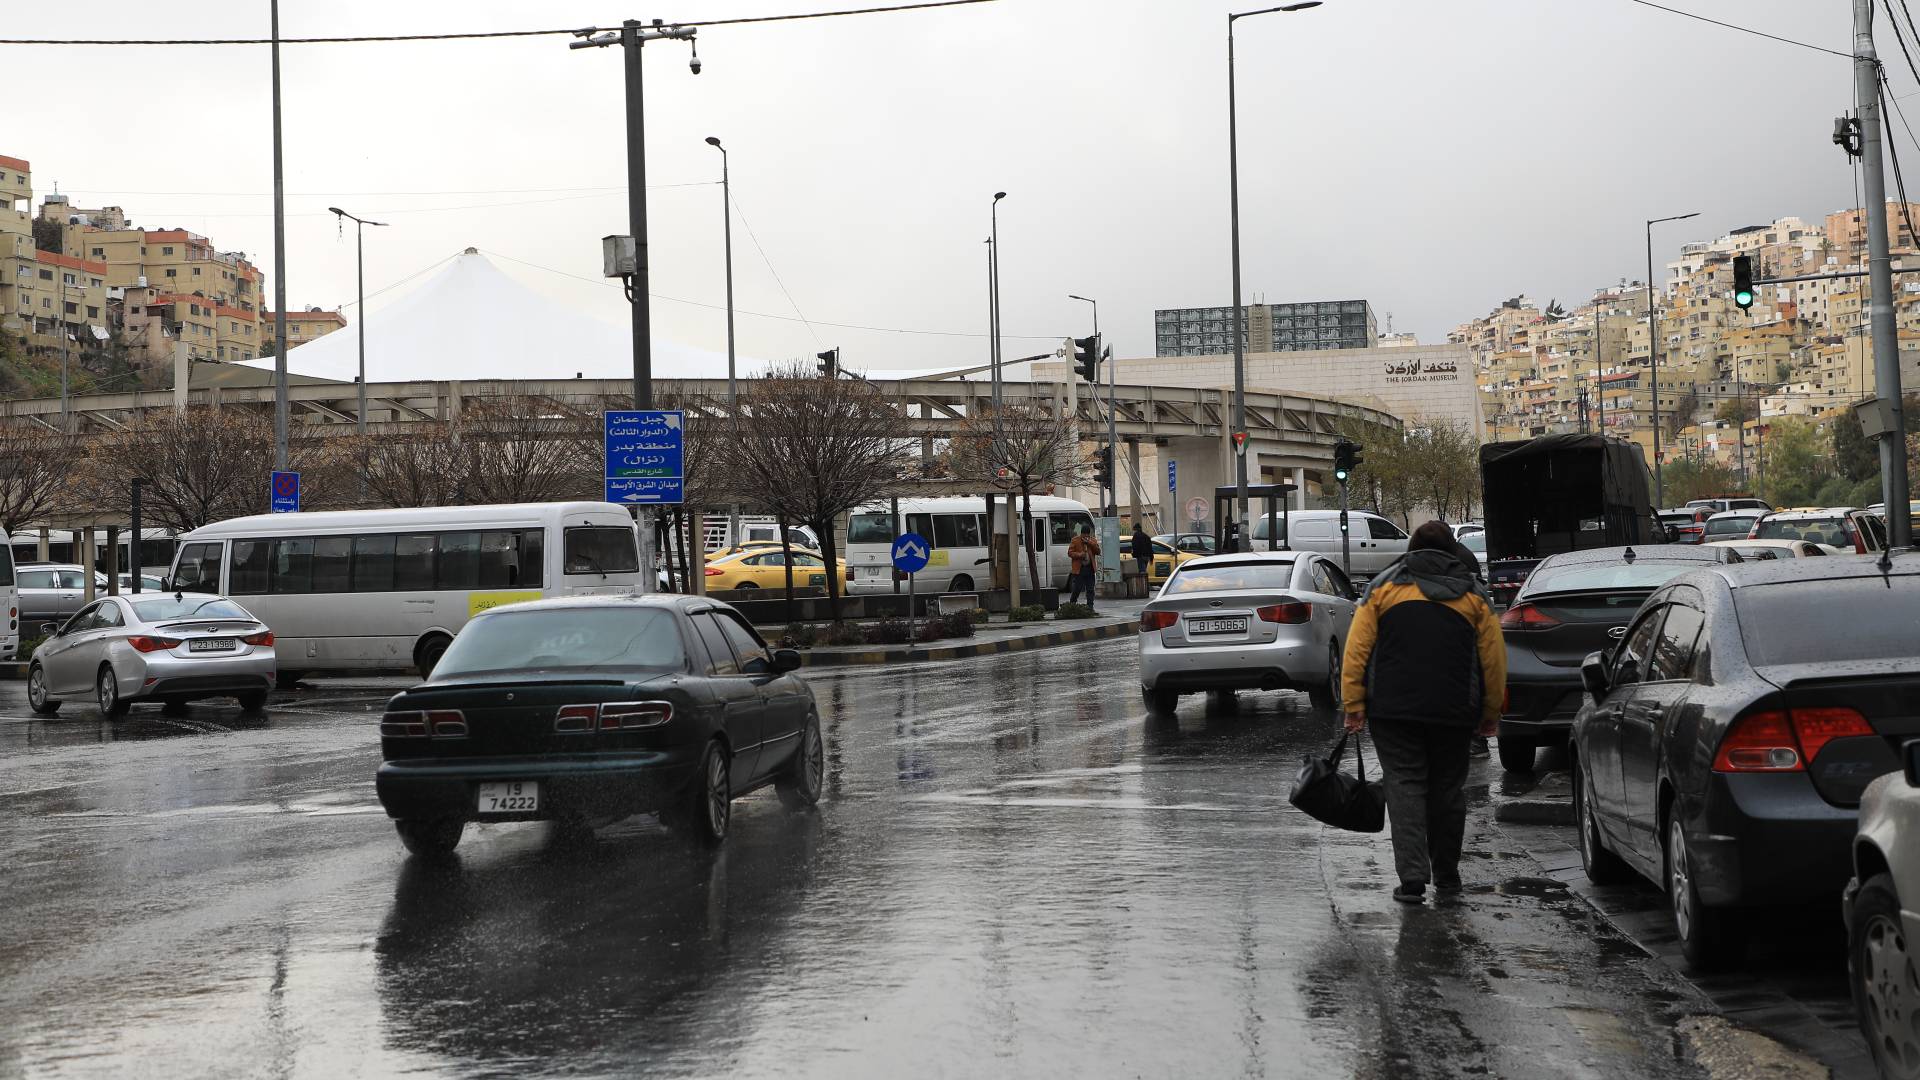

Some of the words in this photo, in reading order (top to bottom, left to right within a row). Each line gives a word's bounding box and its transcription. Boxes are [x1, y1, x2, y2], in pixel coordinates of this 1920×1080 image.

[1429, 374, 1458, 382] MUSEUM
[613, 416, 639, 424] عمان
[641, 416, 664, 425] جبل
[636, 442, 676, 450] منطقة
[610, 480, 636, 490] الأوسط
[636, 481, 656, 490] الشرق
[658, 481, 679, 490] ميدان
[1199, 620, 1245, 631] 81-50863
[506, 783, 522, 796] 19
[490, 797, 535, 810] 74222
